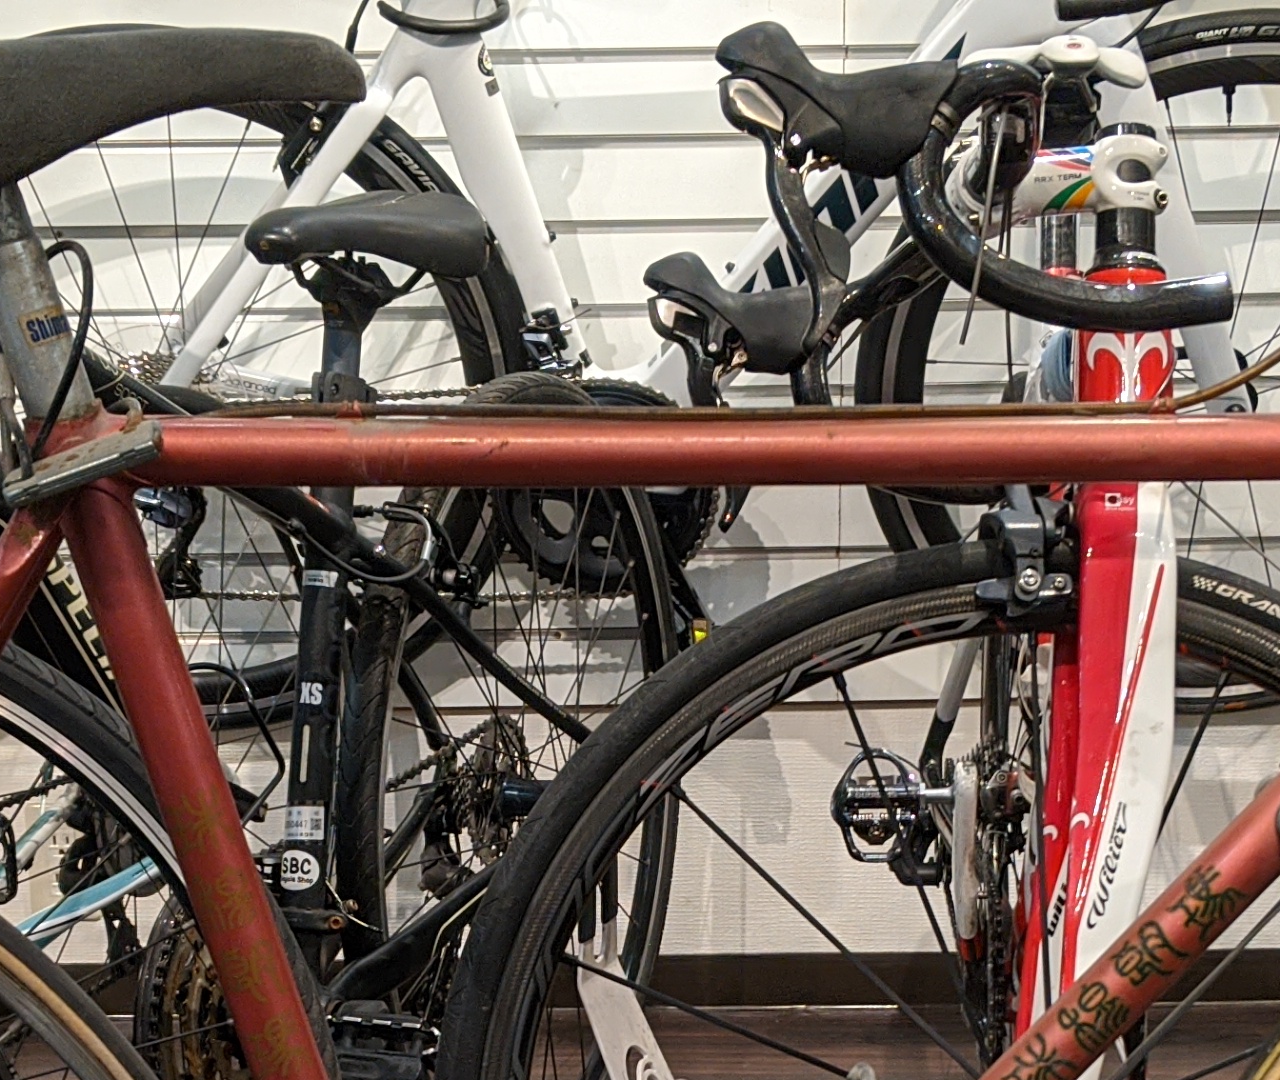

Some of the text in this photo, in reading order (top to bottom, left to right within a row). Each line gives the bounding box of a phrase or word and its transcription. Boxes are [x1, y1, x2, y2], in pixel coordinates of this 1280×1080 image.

[1034, 172, 1082, 183] ARX TEAM
[298, 682, 323, 705] XS
[282, 857, 312, 875] SBC
[1086, 801, 1128, 930] Wilier
